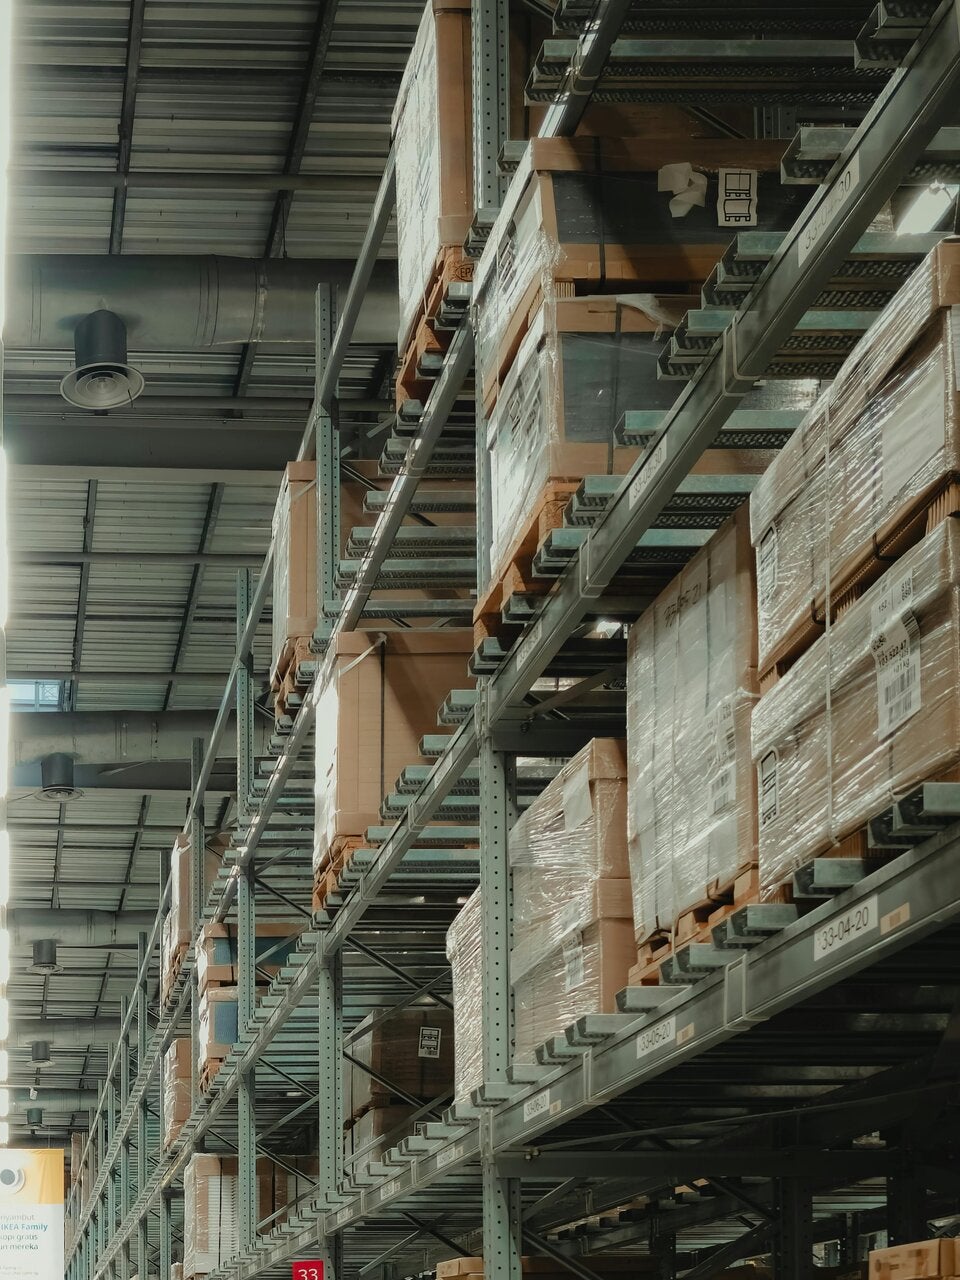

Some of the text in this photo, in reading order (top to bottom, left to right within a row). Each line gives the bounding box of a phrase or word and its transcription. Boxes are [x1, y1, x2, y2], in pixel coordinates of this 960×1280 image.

[822, 906, 869, 950] 33-04-20
[641, 1021, 671, 1052] 33-05-20
[21, 1223, 48, 1232] Family
[16, 1234, 38, 1242] gratis
